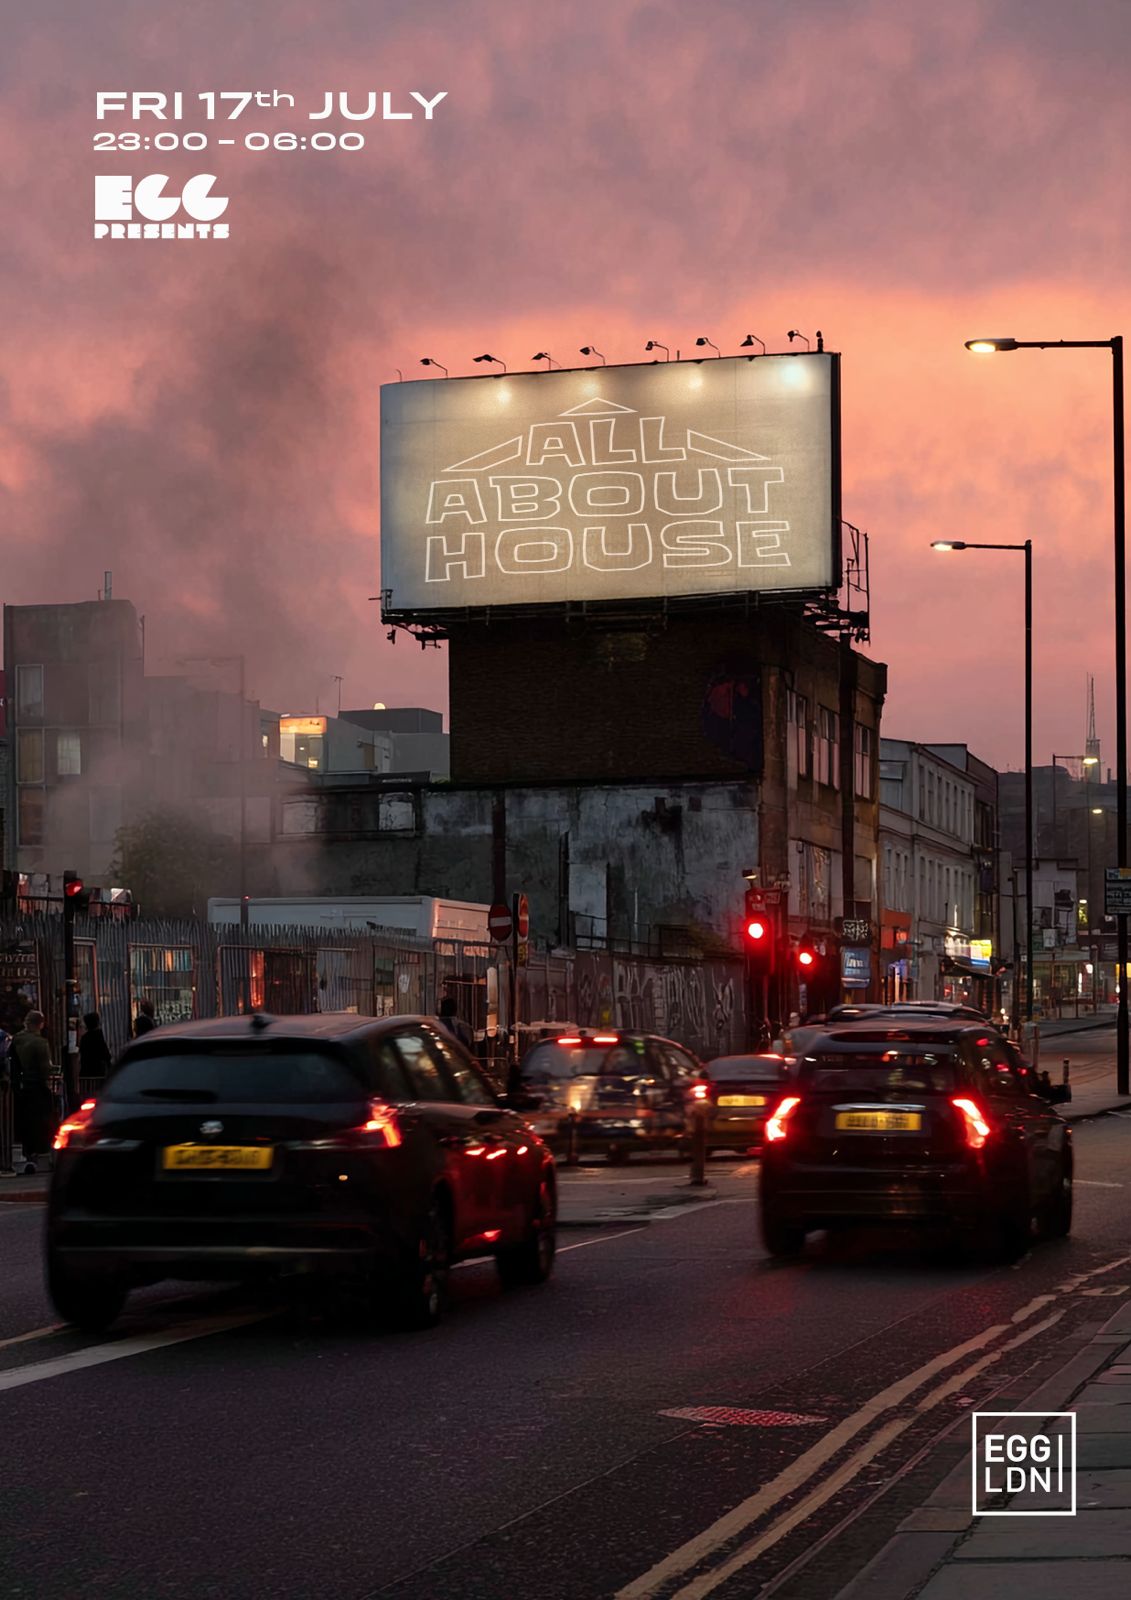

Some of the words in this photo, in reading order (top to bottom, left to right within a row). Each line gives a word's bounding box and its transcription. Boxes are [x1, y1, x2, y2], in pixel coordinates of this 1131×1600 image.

[526, 416, 687, 467] ALL
[425, 466, 785, 525] ABOUT
[425, 520, 792, 583] HOUSE
